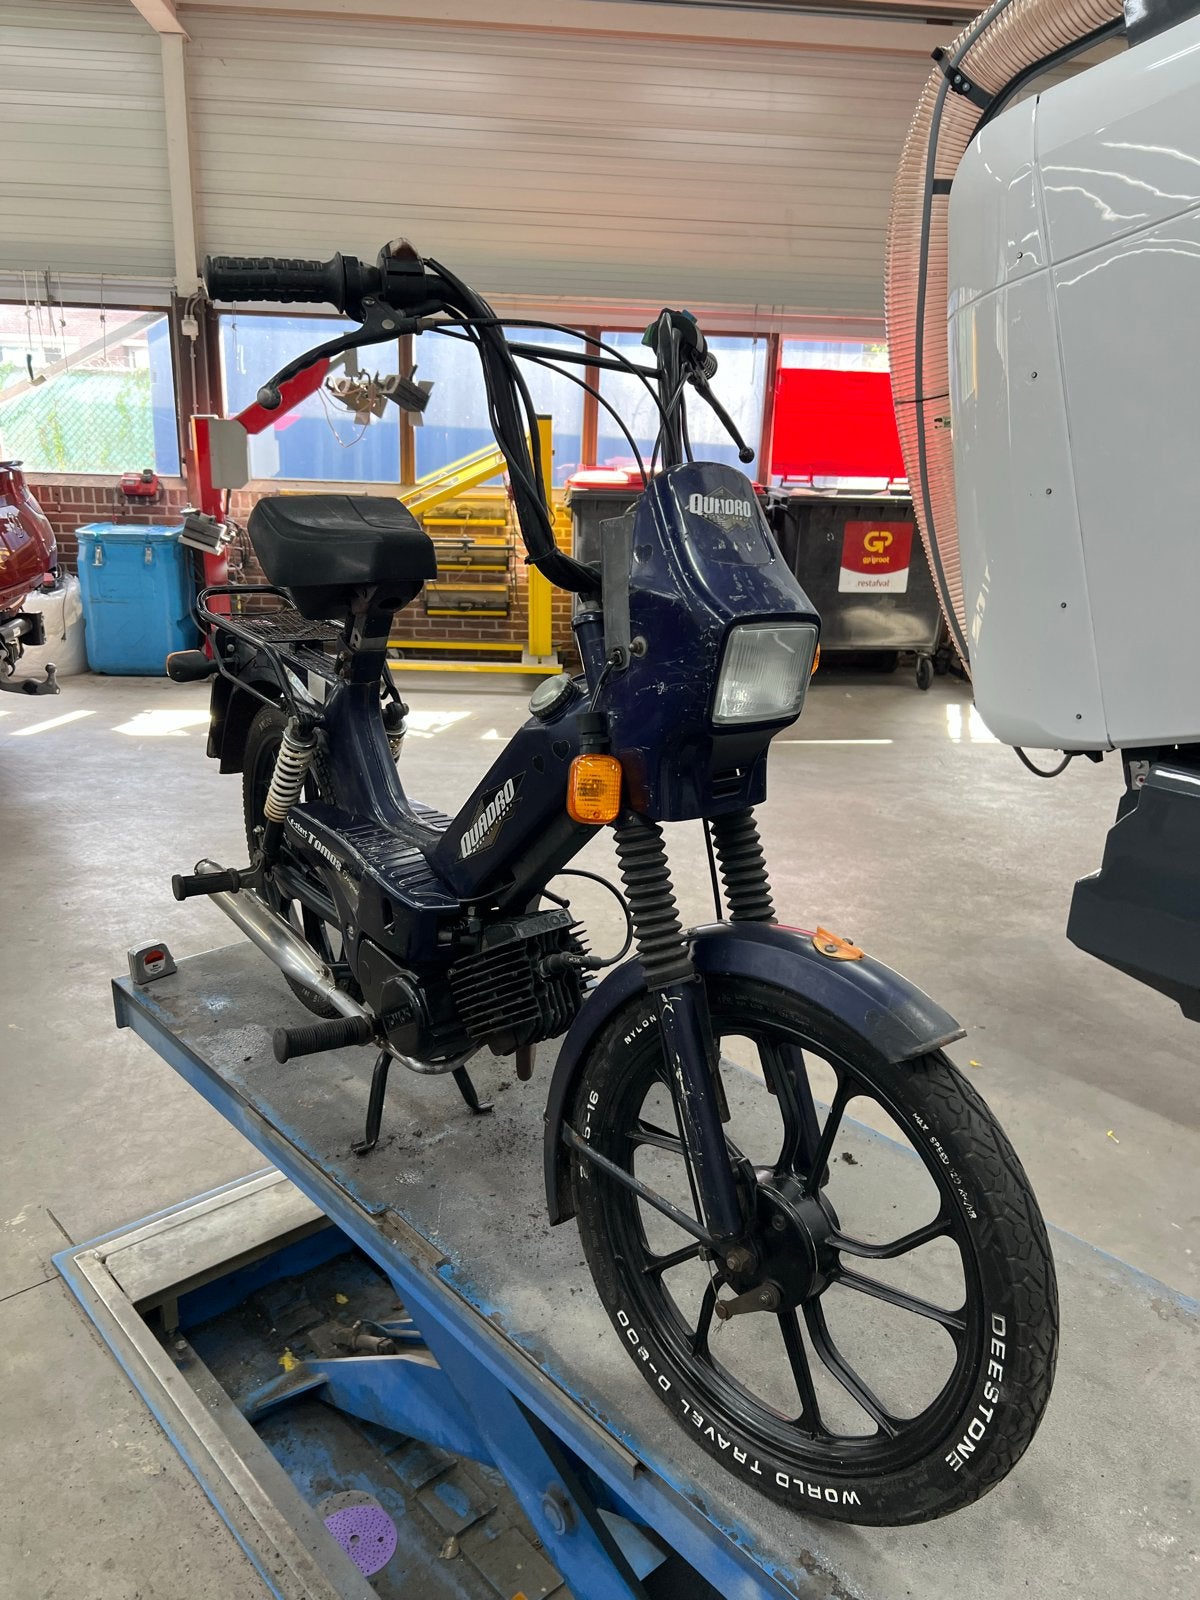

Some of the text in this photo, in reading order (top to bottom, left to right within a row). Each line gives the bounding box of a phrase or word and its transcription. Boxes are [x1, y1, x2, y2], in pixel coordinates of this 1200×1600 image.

[863, 531, 893, 553] GP
[857, 579, 890, 588] restafval
[460, 778, 515, 859] QUADRO
[623, 1013, 658, 1045] NYLON
[912, 1112, 930, 1131] MAX
[929, 1136, 950, 1165] SPEED
[950, 1168, 962, 1185] 20
[616, 1309, 862, 1506] WORLD TRAVEL D-800
[944, 1312, 1007, 1473] DEESTONE
